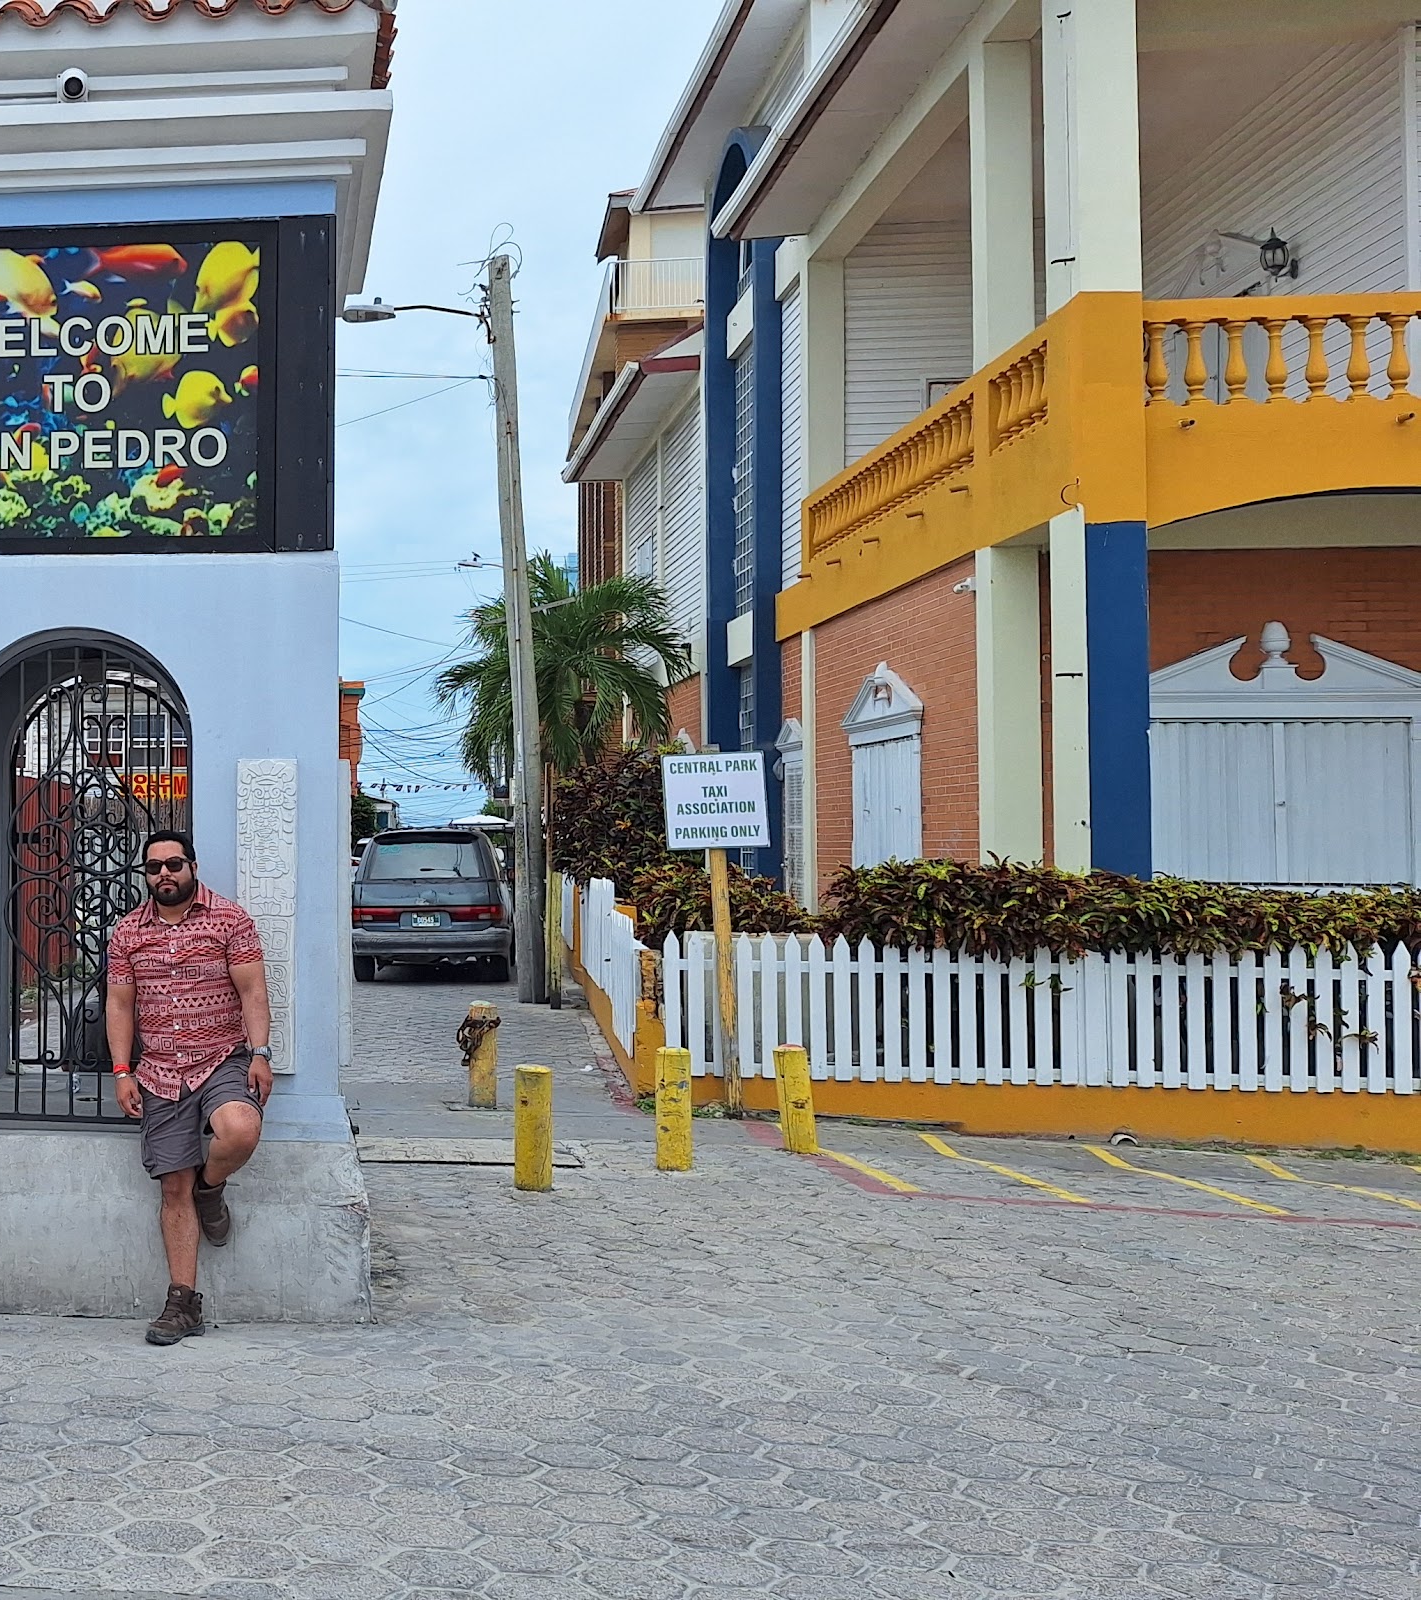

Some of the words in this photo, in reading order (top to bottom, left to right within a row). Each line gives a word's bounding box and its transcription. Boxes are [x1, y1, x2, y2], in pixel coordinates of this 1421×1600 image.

[43, 374, 111, 414] TO
[50, 427, 228, 469] PEDRO
[669, 761, 722, 774] CENTRAL
[725, 759, 757, 772] PARK
[701, 785, 728, 798] TAXI
[676, 801, 756, 816] ASSOCIATION
[674, 826, 728, 840] PARKING
[730, 825, 760, 838] ONLY
